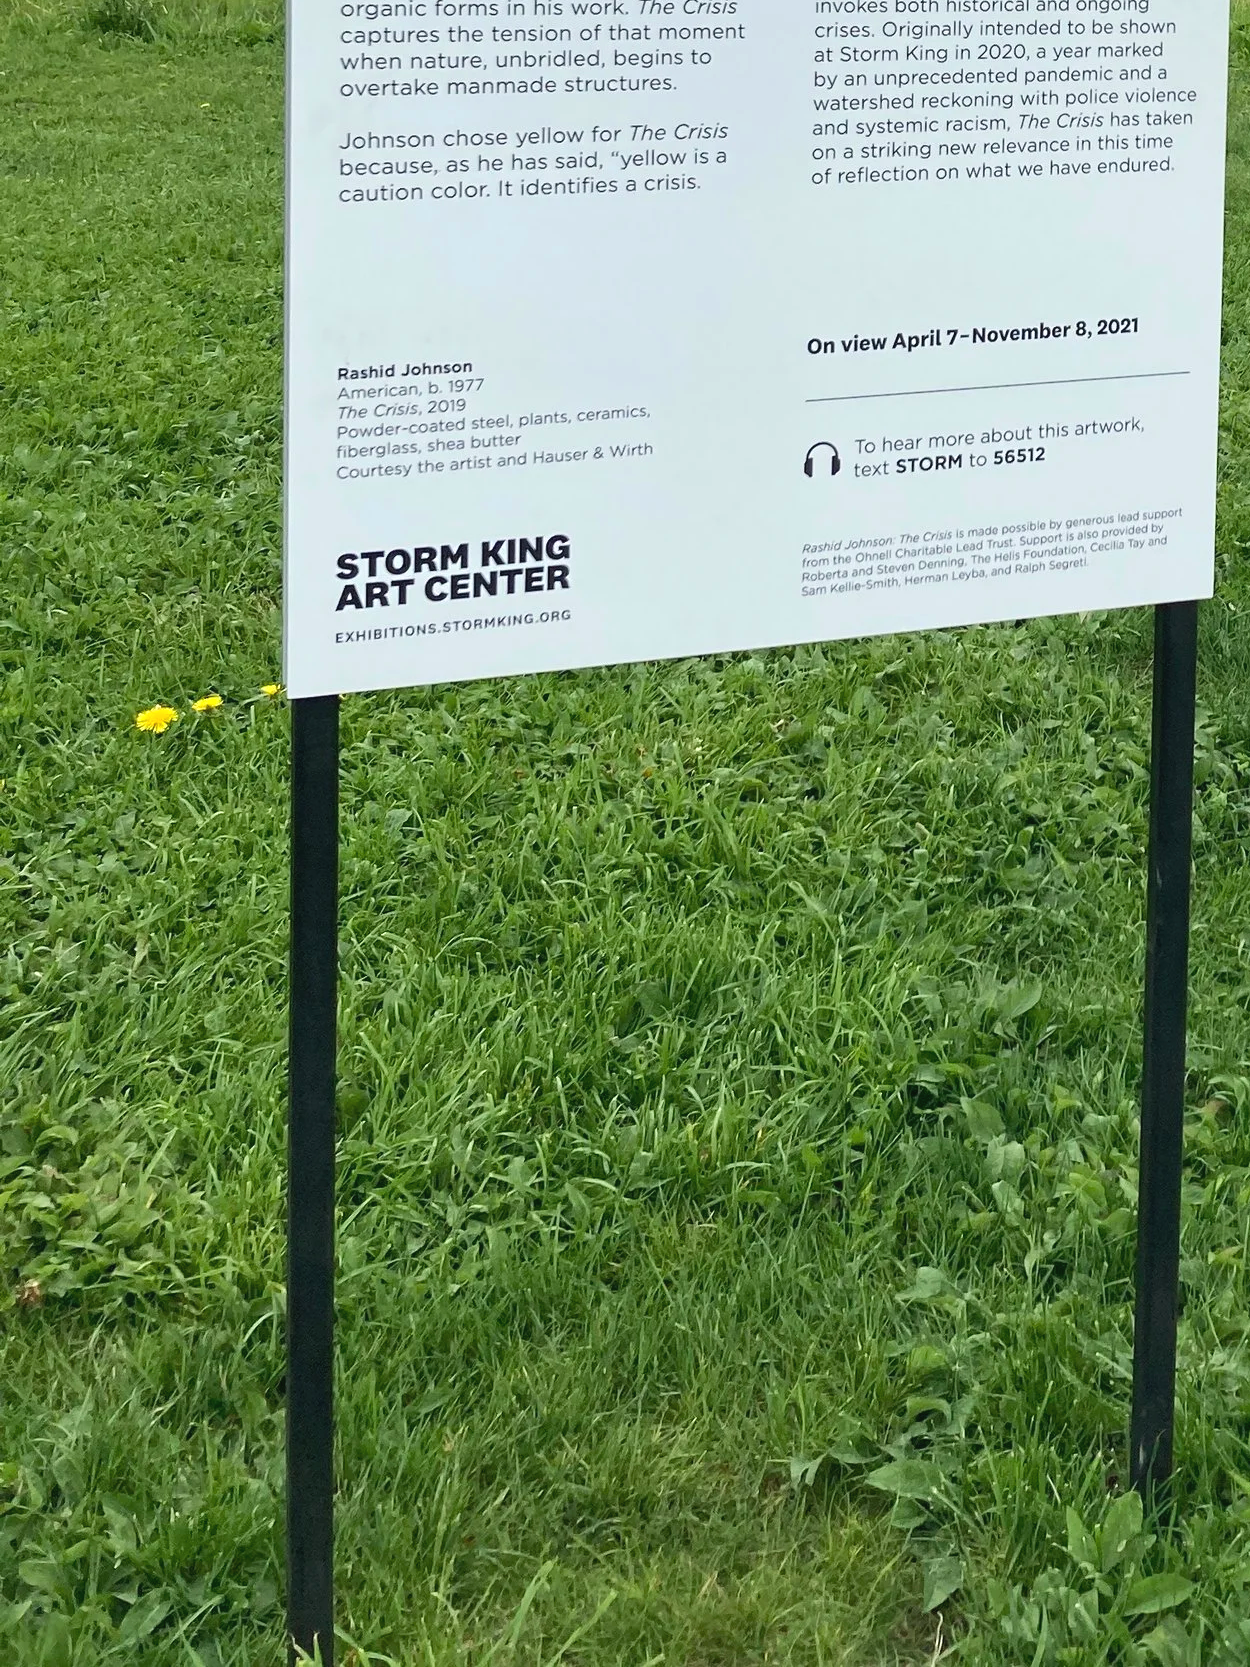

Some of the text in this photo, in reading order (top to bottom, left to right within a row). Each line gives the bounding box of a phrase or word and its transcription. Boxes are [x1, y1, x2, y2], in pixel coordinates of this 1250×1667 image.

[339, 48, 712, 71] when nature, unbridled, begins to
[814, 41, 1164, 64] at Storm King in 2020, a year marked
[813, 87, 1197, 111] watershed reckoning with police violence
[338, 173, 701, 203] caution color. It identifies a crisis.
[807, 338, 836, 355] On
[840, 333, 888, 353] view
[891, 328, 942, 353] April
[1075, 320, 1093, 340] 8,
[1097, 317, 1139, 336] 2021
[337, 362, 473, 381] Rashid Johnson
[336, 377, 485, 401] American, b. 1977
[336, 405, 651, 440] Powder-coated steel, plants, ceramics,
[338, 398, 467, 420] The Crisis, 2019
[336, 434, 522, 459] fiberglass, shea butter
[854, 415, 1145, 455] To hear more about this artwork,
[336, 442, 654, 480] Courtesy the artist and Hauser & Wirth
[854, 446, 1046, 479] text STORM to 56512
[336, 534, 571, 581] STORM KING
[335, 564, 571, 612] ART CENTER
[335, 609, 571, 644] EXHIBITIONS.STORMKING.ORG
